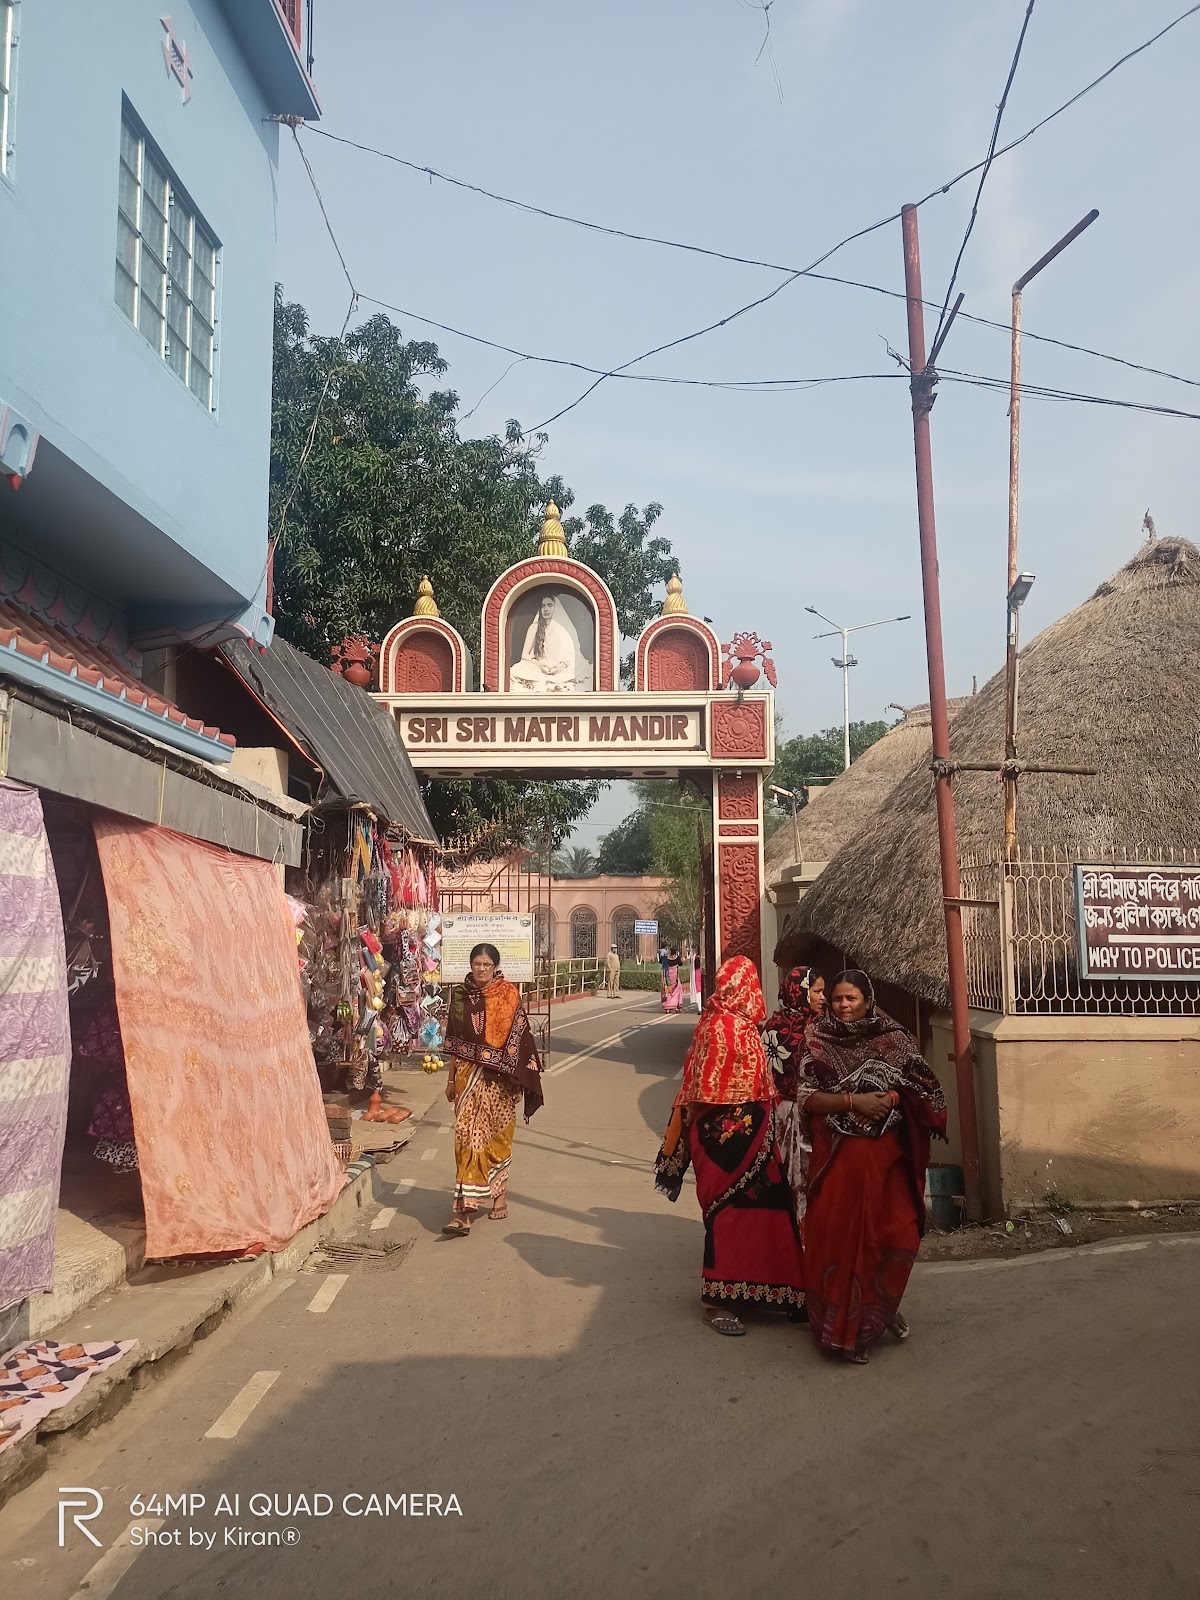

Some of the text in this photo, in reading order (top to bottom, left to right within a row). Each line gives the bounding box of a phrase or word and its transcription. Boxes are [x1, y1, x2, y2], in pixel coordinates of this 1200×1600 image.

[408, 714, 689, 743] SRI SRI MATRI MANDIR
[1084, 905, 1113, 928] জন্য
[1112, 901, 1150, 932] পুলিশ
[1088, 946, 1200, 969] WAY TO POLICE
